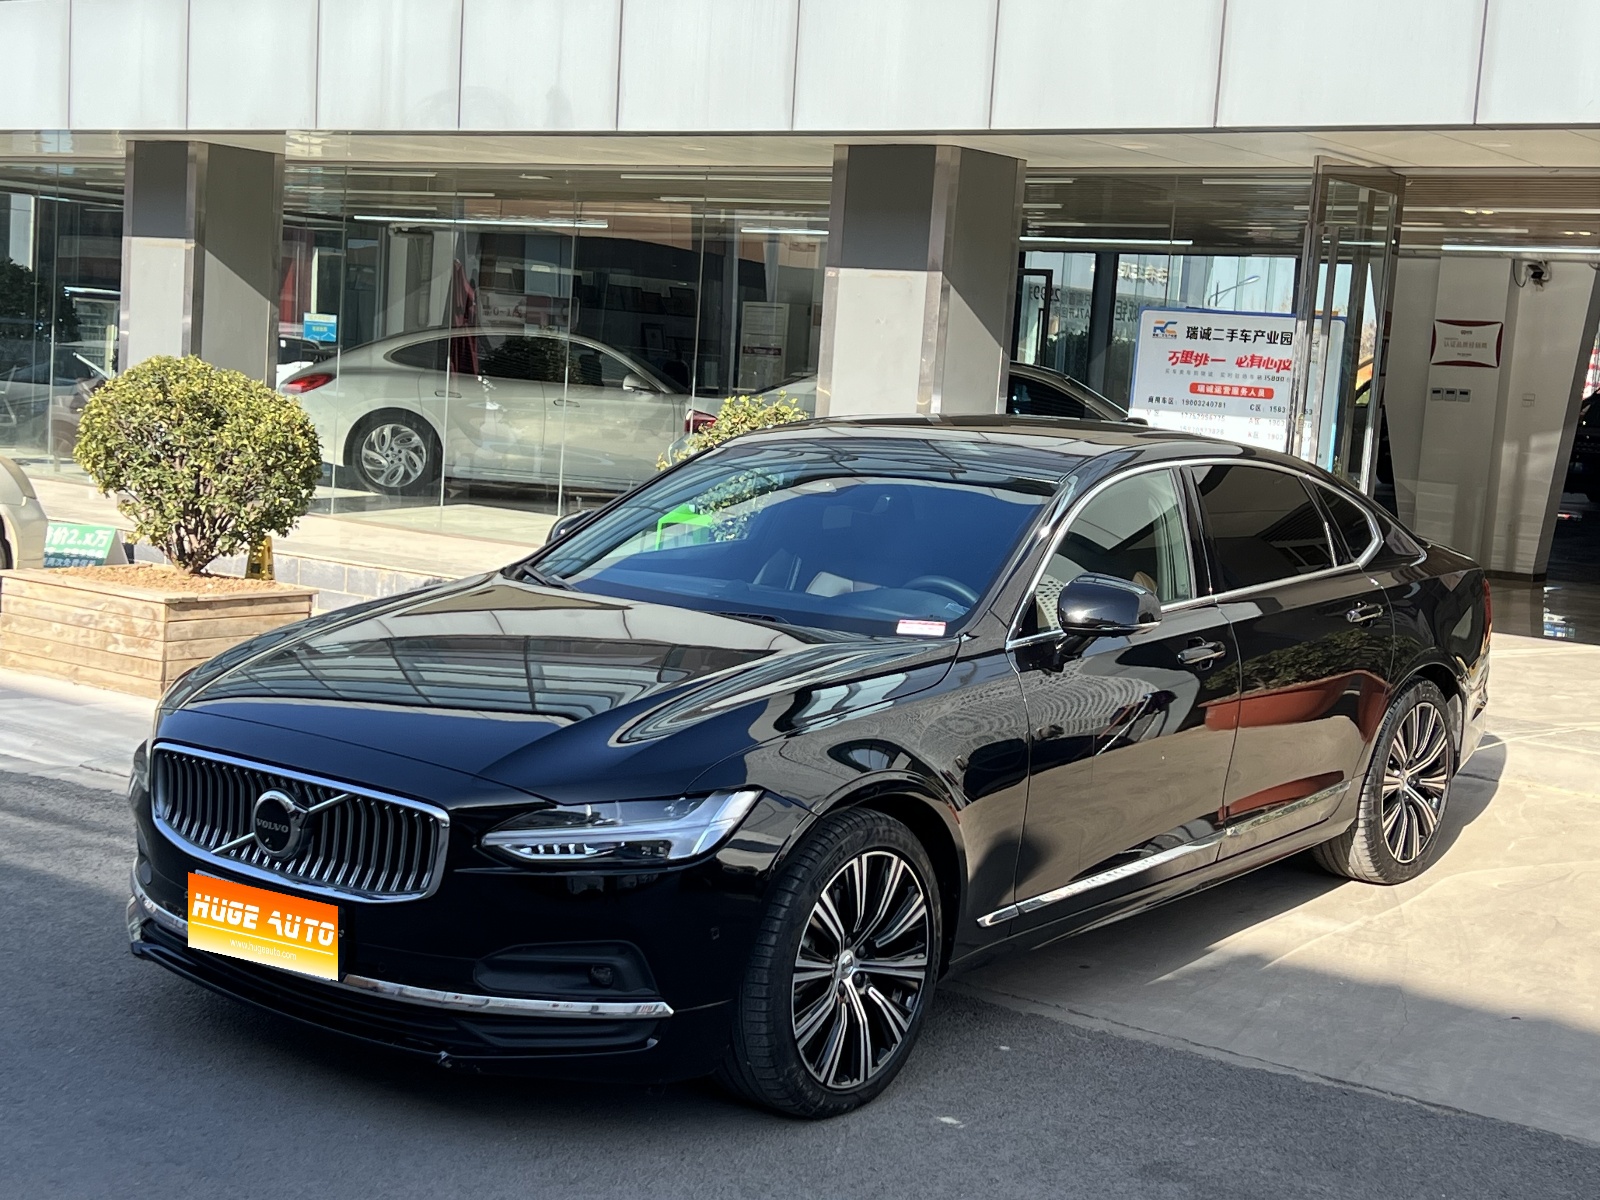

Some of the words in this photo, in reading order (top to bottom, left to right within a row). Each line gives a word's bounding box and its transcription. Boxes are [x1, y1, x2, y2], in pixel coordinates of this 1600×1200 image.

[1186, 325, 1293, 346] 瑞诚二手车产业园
[1168, 349, 1226, 367] 万里挑一
[256, 818, 289, 833] VOLVO
